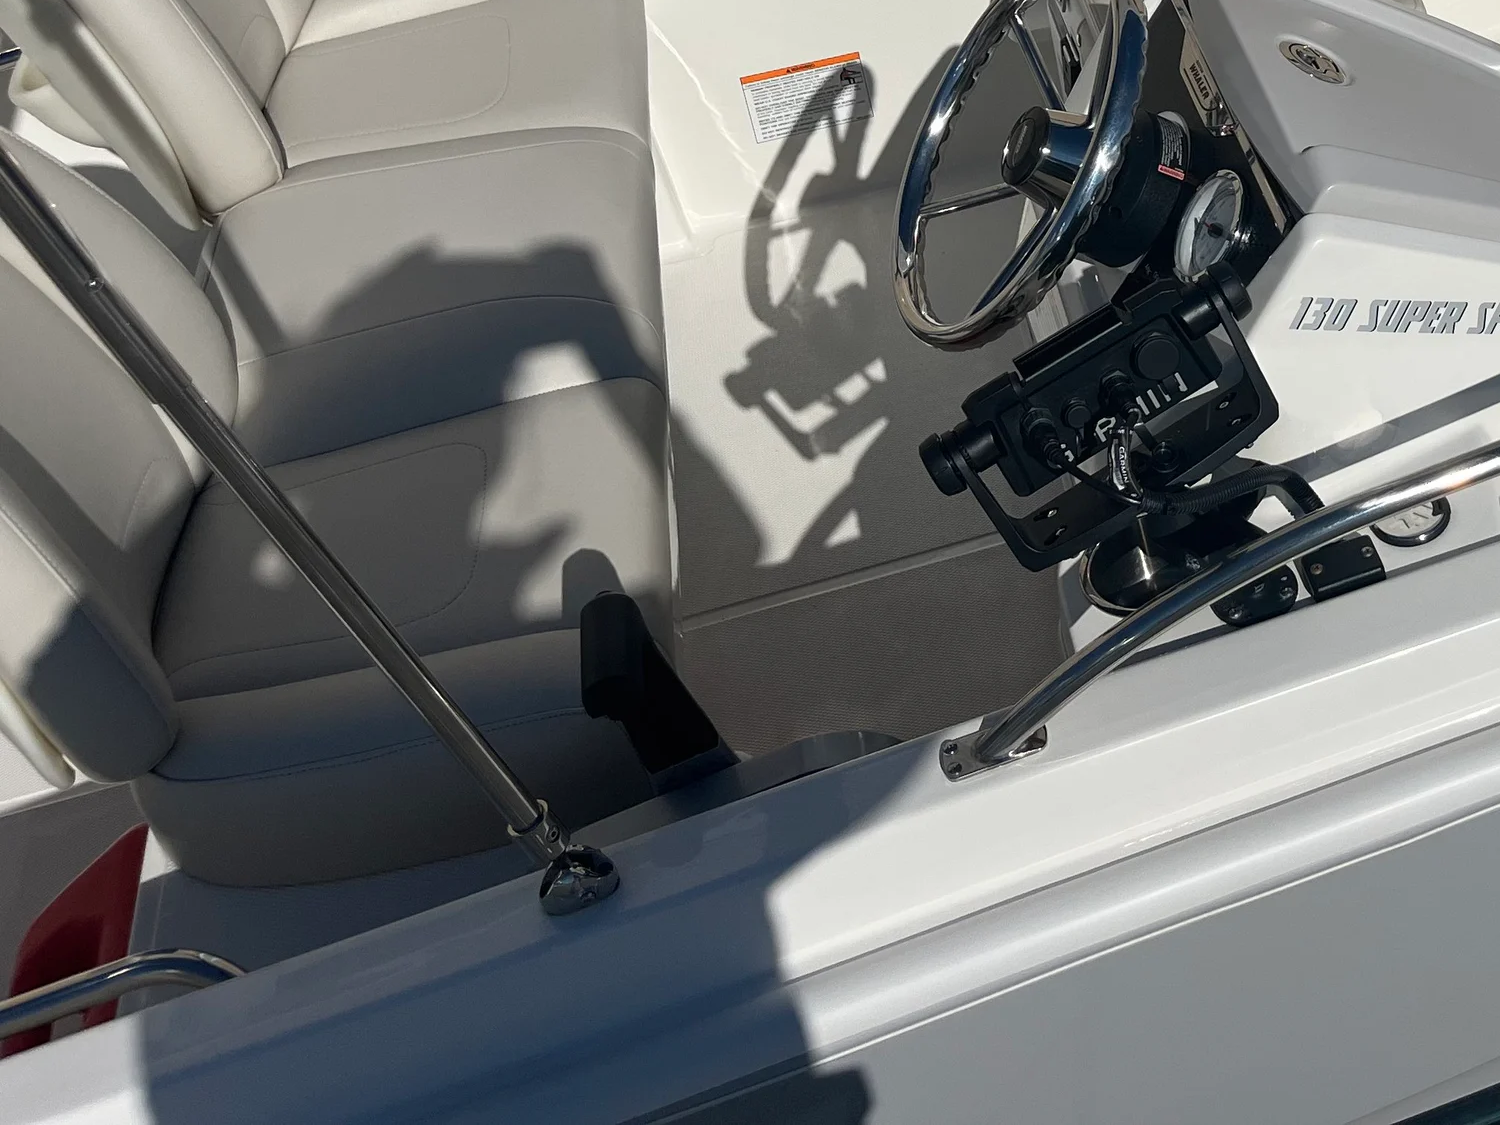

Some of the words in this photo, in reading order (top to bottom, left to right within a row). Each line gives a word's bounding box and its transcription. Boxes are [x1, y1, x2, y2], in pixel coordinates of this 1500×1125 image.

[1189, 62, 1210, 100] WHALER
[1289, 296, 1358, 331] 130
[1356, 299, 1468, 334] SUPER
[1118, 446, 1130, 484] GARMIN
